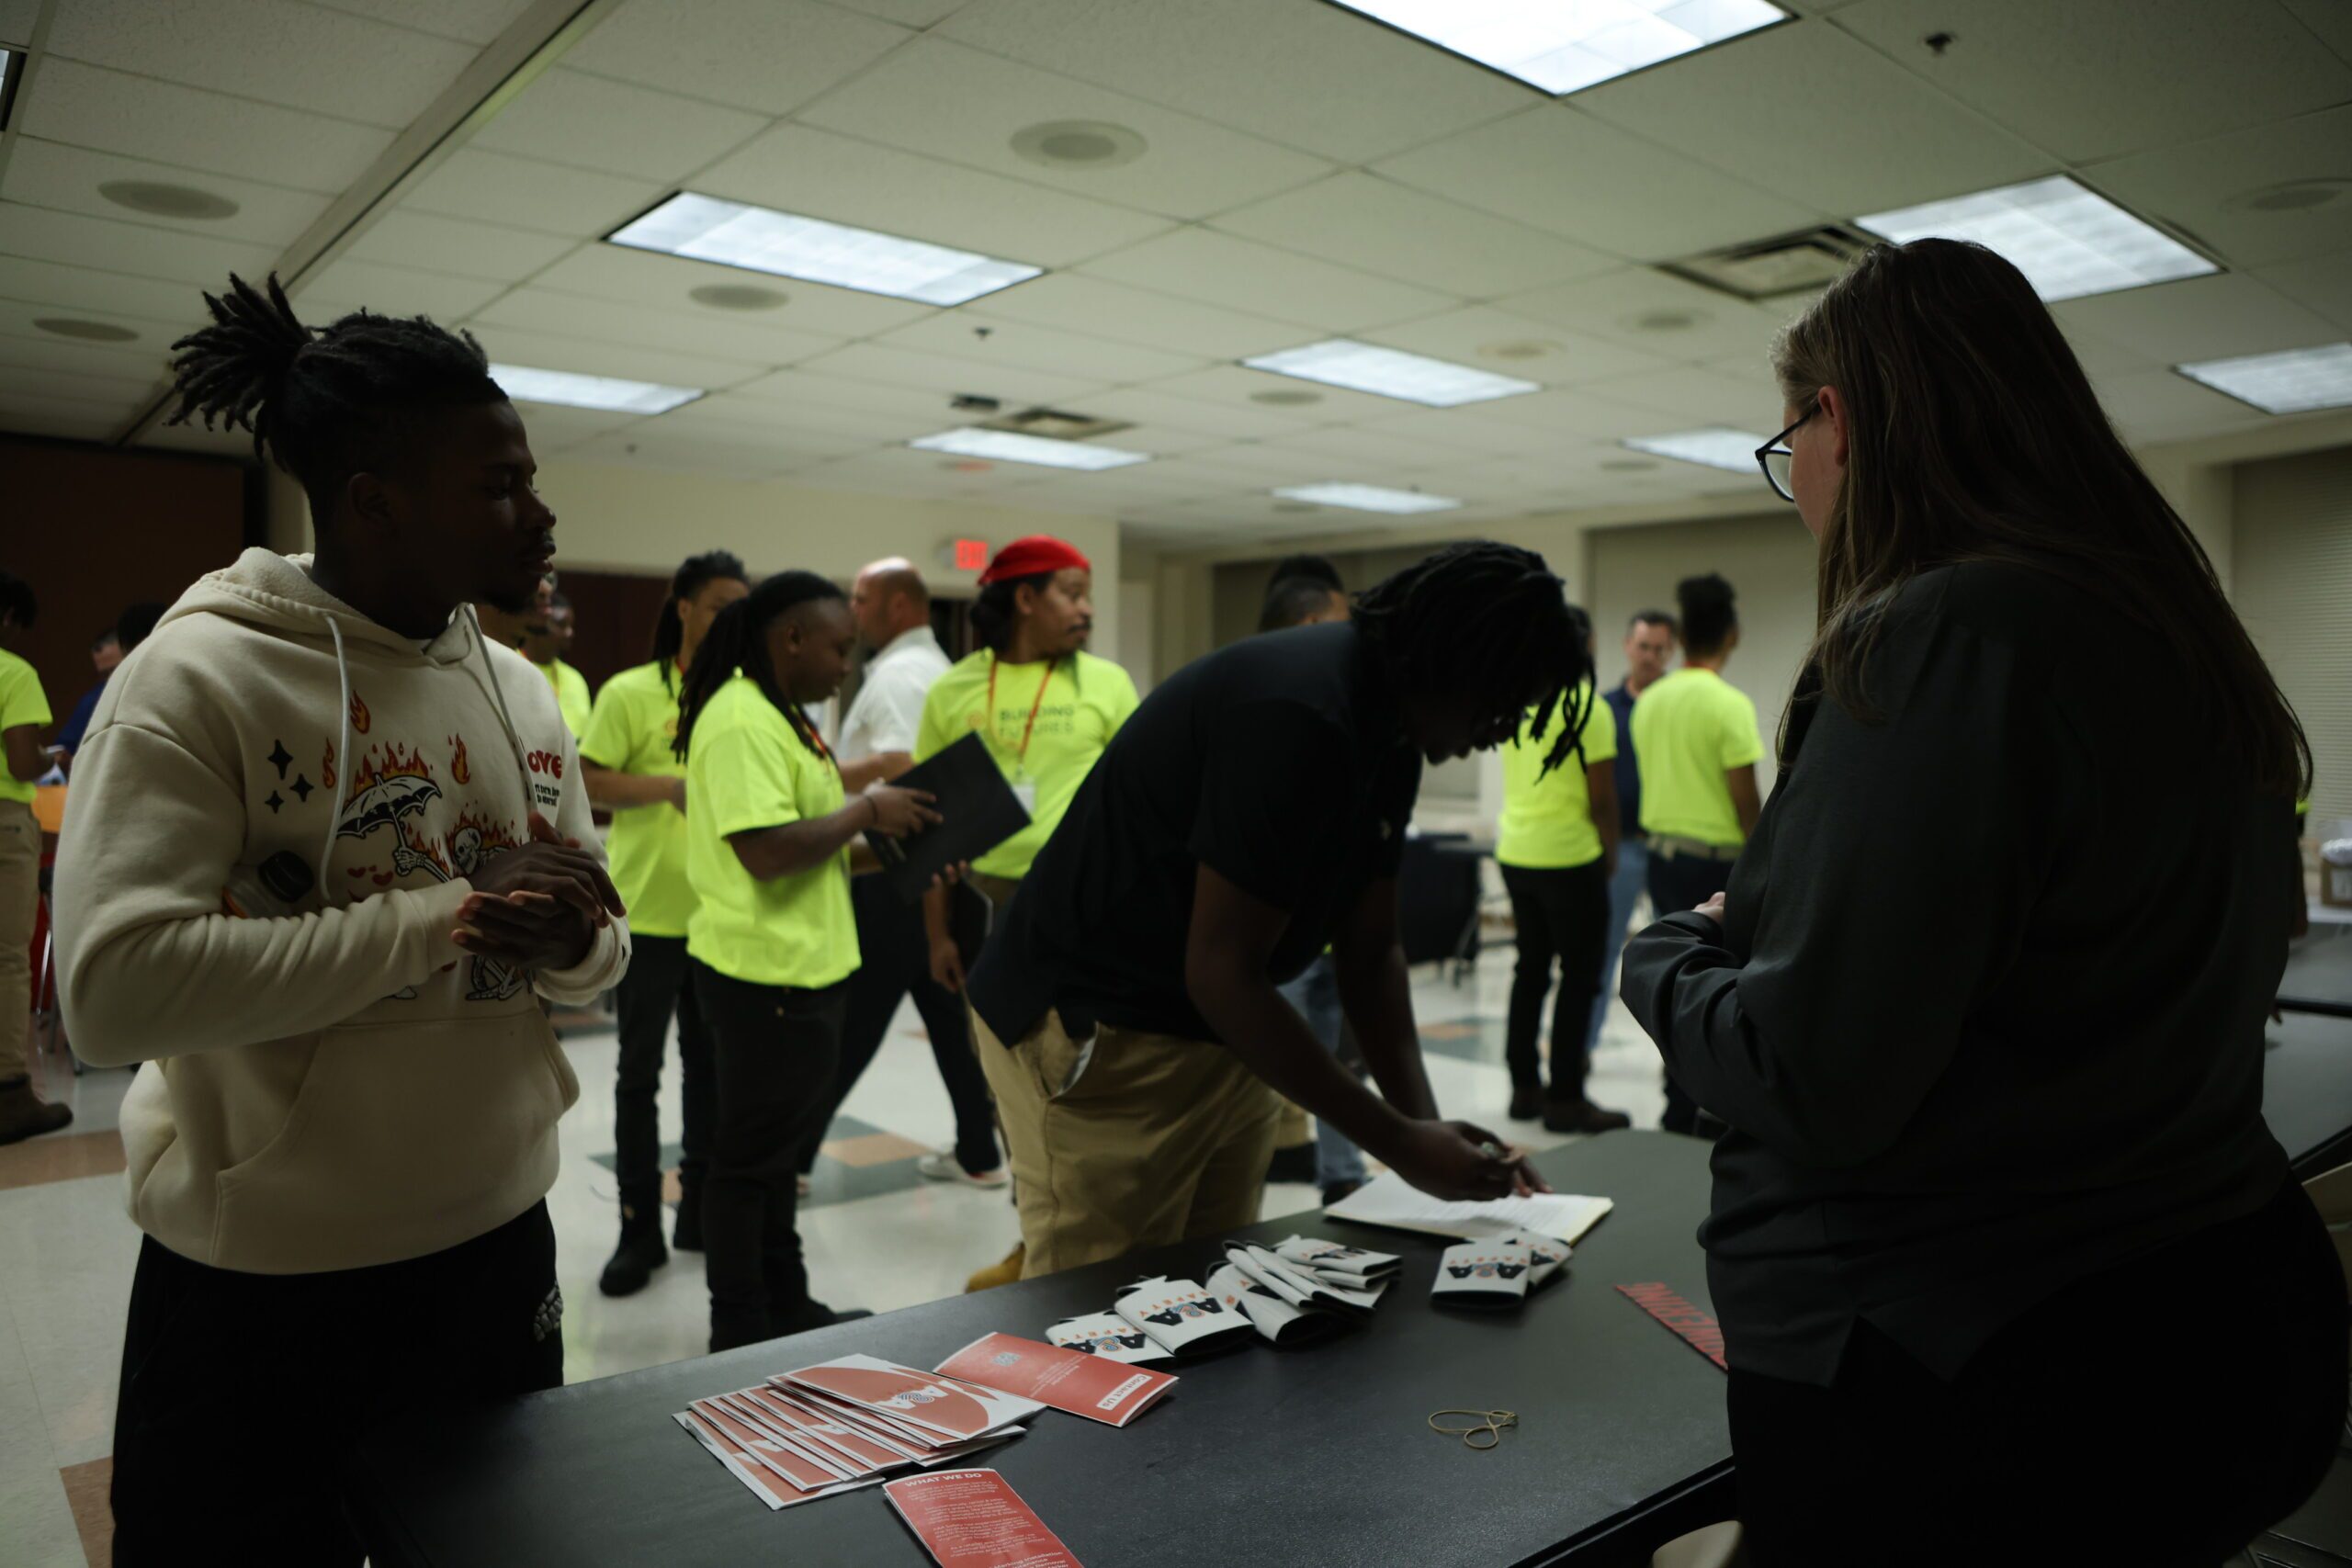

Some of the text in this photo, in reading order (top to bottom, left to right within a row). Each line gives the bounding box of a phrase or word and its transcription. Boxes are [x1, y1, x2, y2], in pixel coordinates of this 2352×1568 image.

[1144, 1297, 1223, 1326] A&A
[1102, 1375, 1148, 1407] Contact Us
[904, 1477, 940, 1487] WHAT
